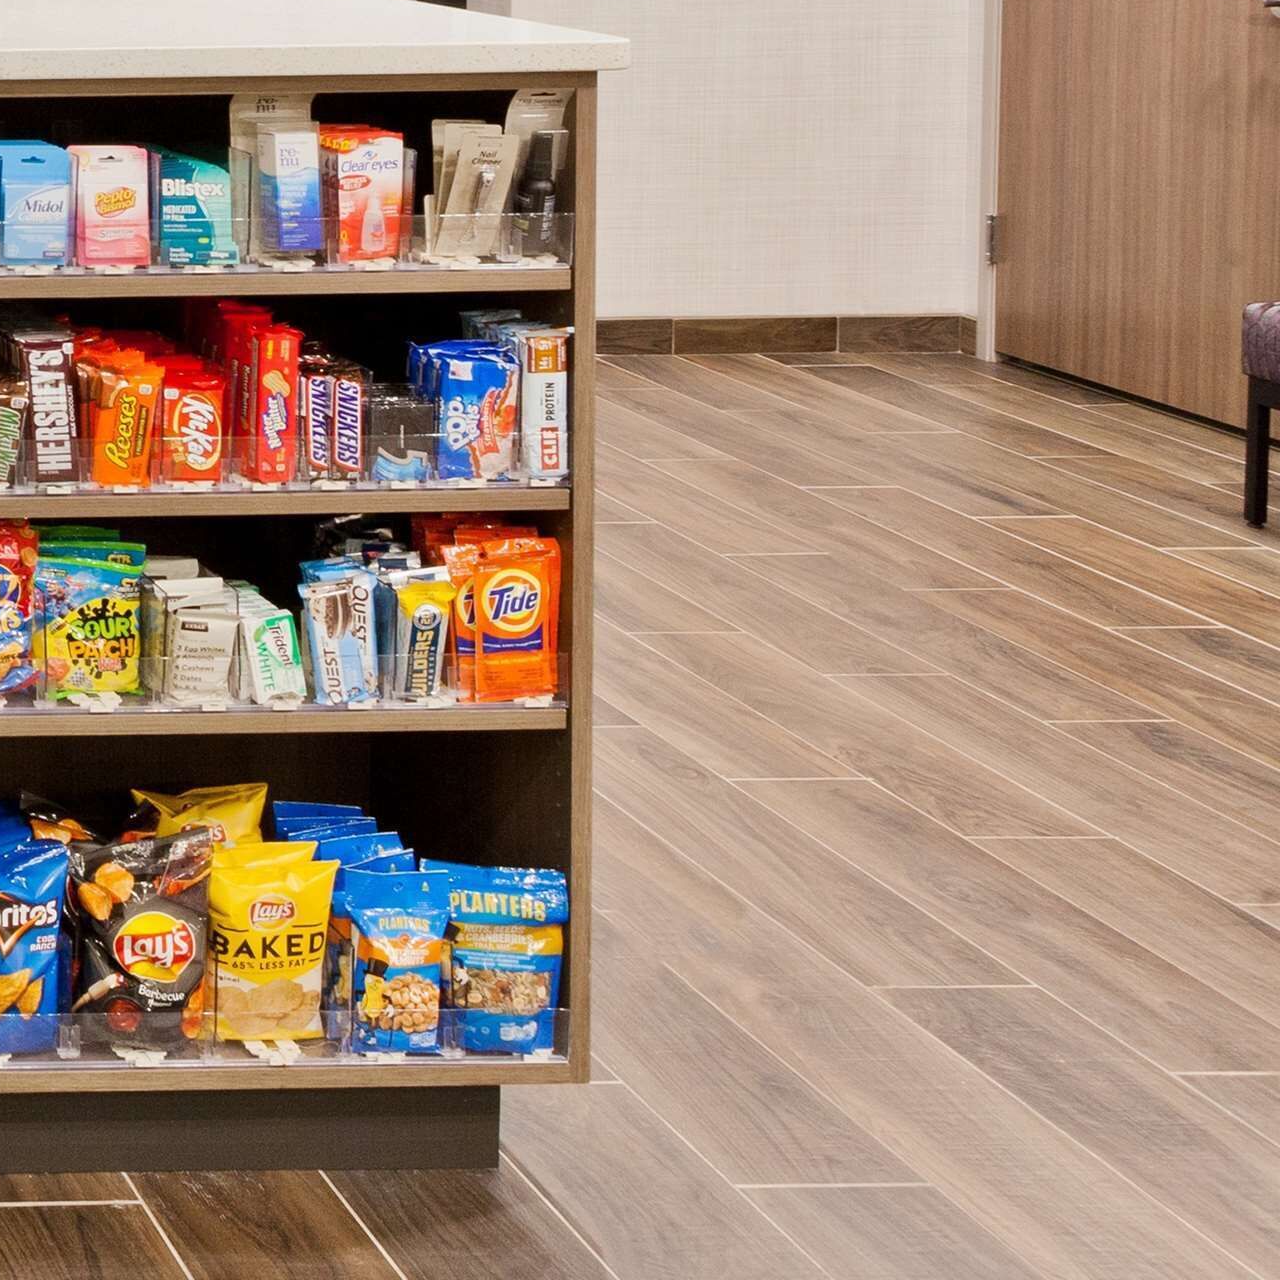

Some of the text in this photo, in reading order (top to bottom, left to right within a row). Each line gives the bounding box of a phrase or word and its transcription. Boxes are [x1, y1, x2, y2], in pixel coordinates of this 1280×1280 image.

[279, 157, 300, 167] nu
[341, 158, 399, 173] Clear eyes
[471, 157, 502, 166] Clipper
[478, 150, 498, 158] Nail
[161, 179, 224, 201] Blistex
[23, 200, 65, 214] Midol
[28, 349, 73, 471] HERSHEY'S
[546, 381, 555, 421] PROTEIN
[105, 393, 136, 469] Reese's
[309, 377, 328, 466] SNICKERS
[337, 379, 359, 468] SNICKERS
[542, 427, 559, 465] CLIF
[488, 585, 539, 621] Tide
[351, 586, 369, 644] QUEST
[69, 616, 132, 641] SOUR
[68, 638, 135, 659] PATCH
[200, 645, 225, 653] Whites
[268, 623, 294, 667] Trident
[180, 674, 202, 682] Dates
[256, 641, 276, 693] WHITE
[323, 648, 343, 705] QUEST
[253, 901, 293, 921] Lay's
[449, 891, 547, 921] PLANTERS
[378, 916, 430, 933] PLANTERS
[29, 942, 58, 952] RANCH
[35, 934, 57, 944] COOL
[123, 926, 190, 968] Lay's
[211, 931, 325, 960] BAKED
[231, 958, 306, 970] 65% LESS FAT
[138, 984, 185, 1002] Barbecue
